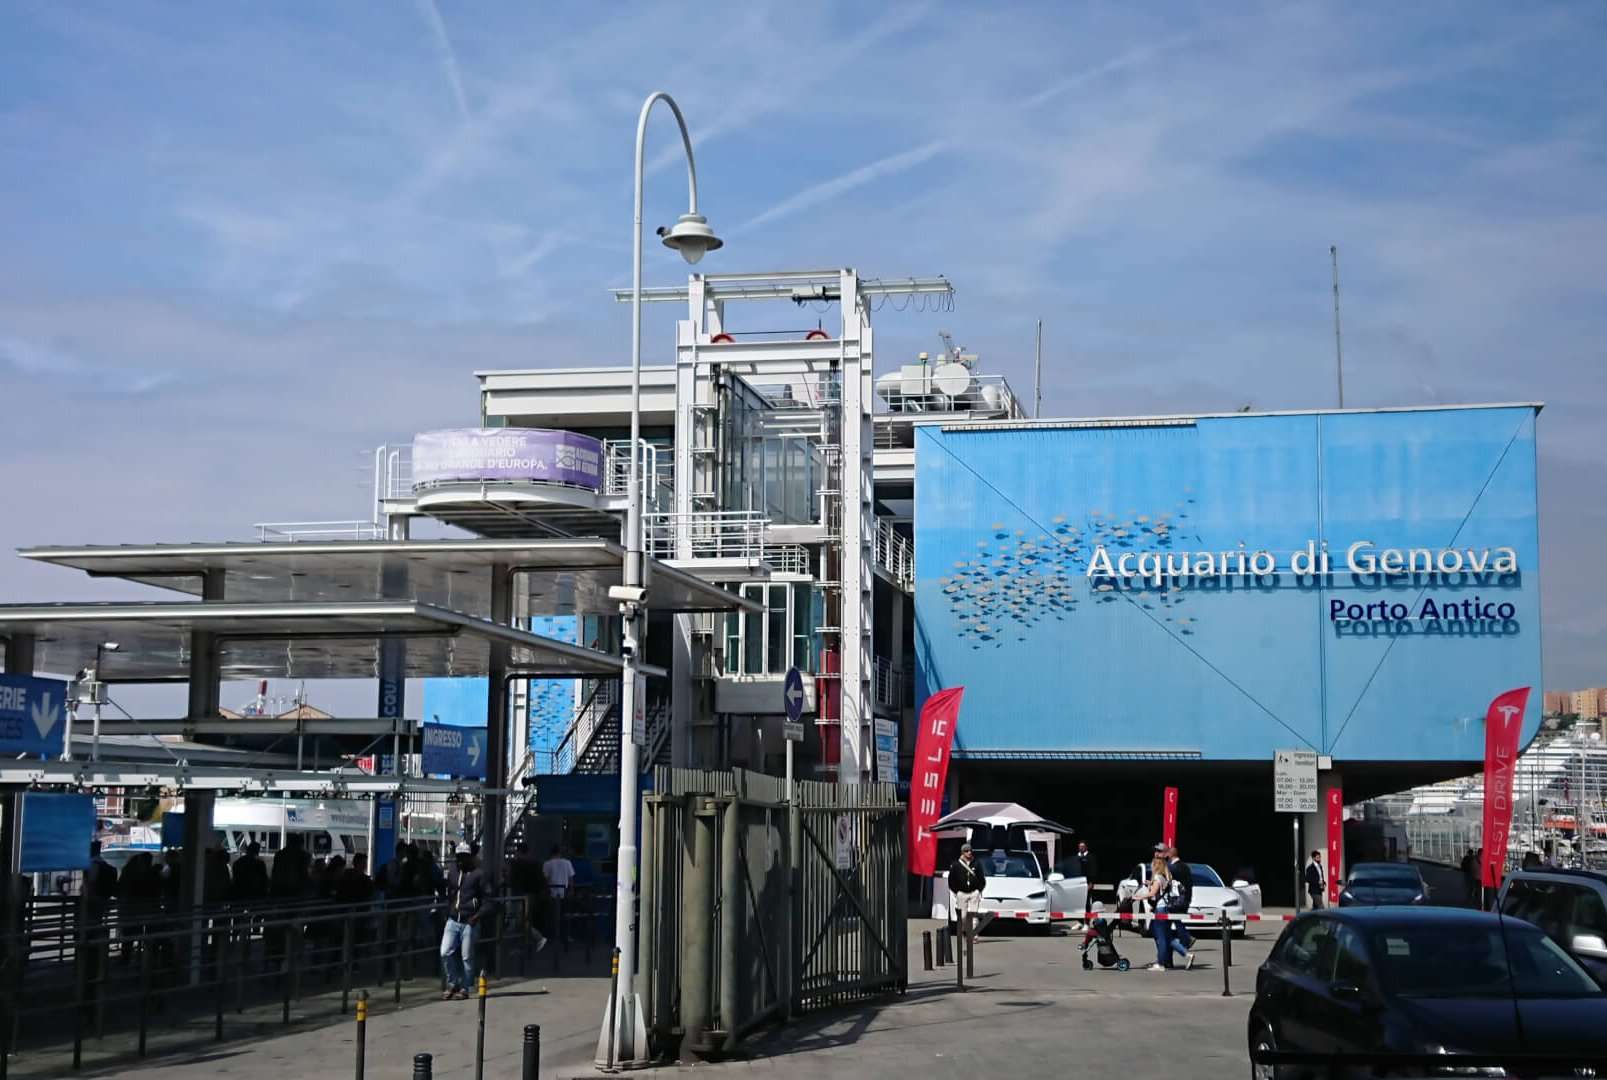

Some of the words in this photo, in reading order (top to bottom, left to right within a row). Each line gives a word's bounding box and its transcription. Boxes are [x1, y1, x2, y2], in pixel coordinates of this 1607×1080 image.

[1087, 542, 1275, 586] Acquario
[1291, 540, 1329, 575] di
[1347, 541, 1518, 575] Genova
[1330, 598, 1408, 622] Porto
[1419, 596, 1516, 620] Antico
[424, 727, 463, 748] INGRESSO
[917, 719, 948, 843] TESLA
[1494, 744, 1510, 811] DRIVE
